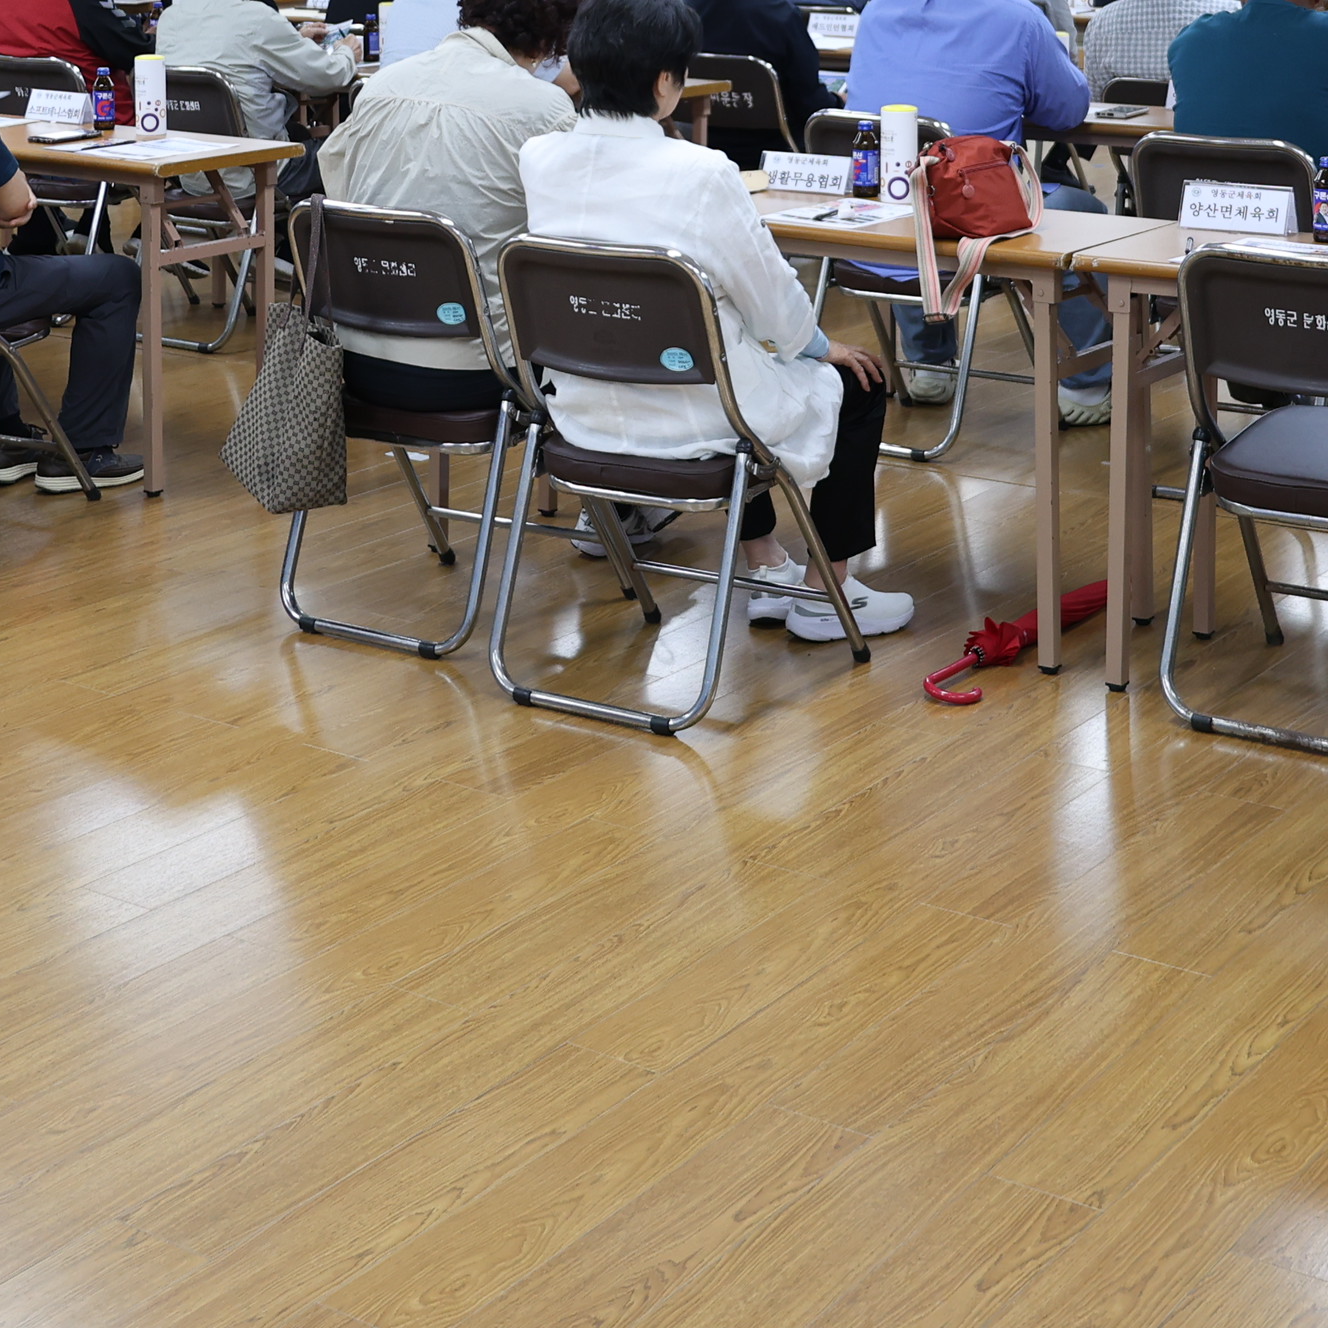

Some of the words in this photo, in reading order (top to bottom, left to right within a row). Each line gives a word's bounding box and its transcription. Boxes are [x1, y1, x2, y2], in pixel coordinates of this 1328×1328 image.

[768, 170, 843, 190] 생활무용협회
[1210, 188, 1263, 200] 영동군체육회
[1189, 201, 1280, 223] 양산면체육회
[1264, 307, 1298, 328] 영동군
